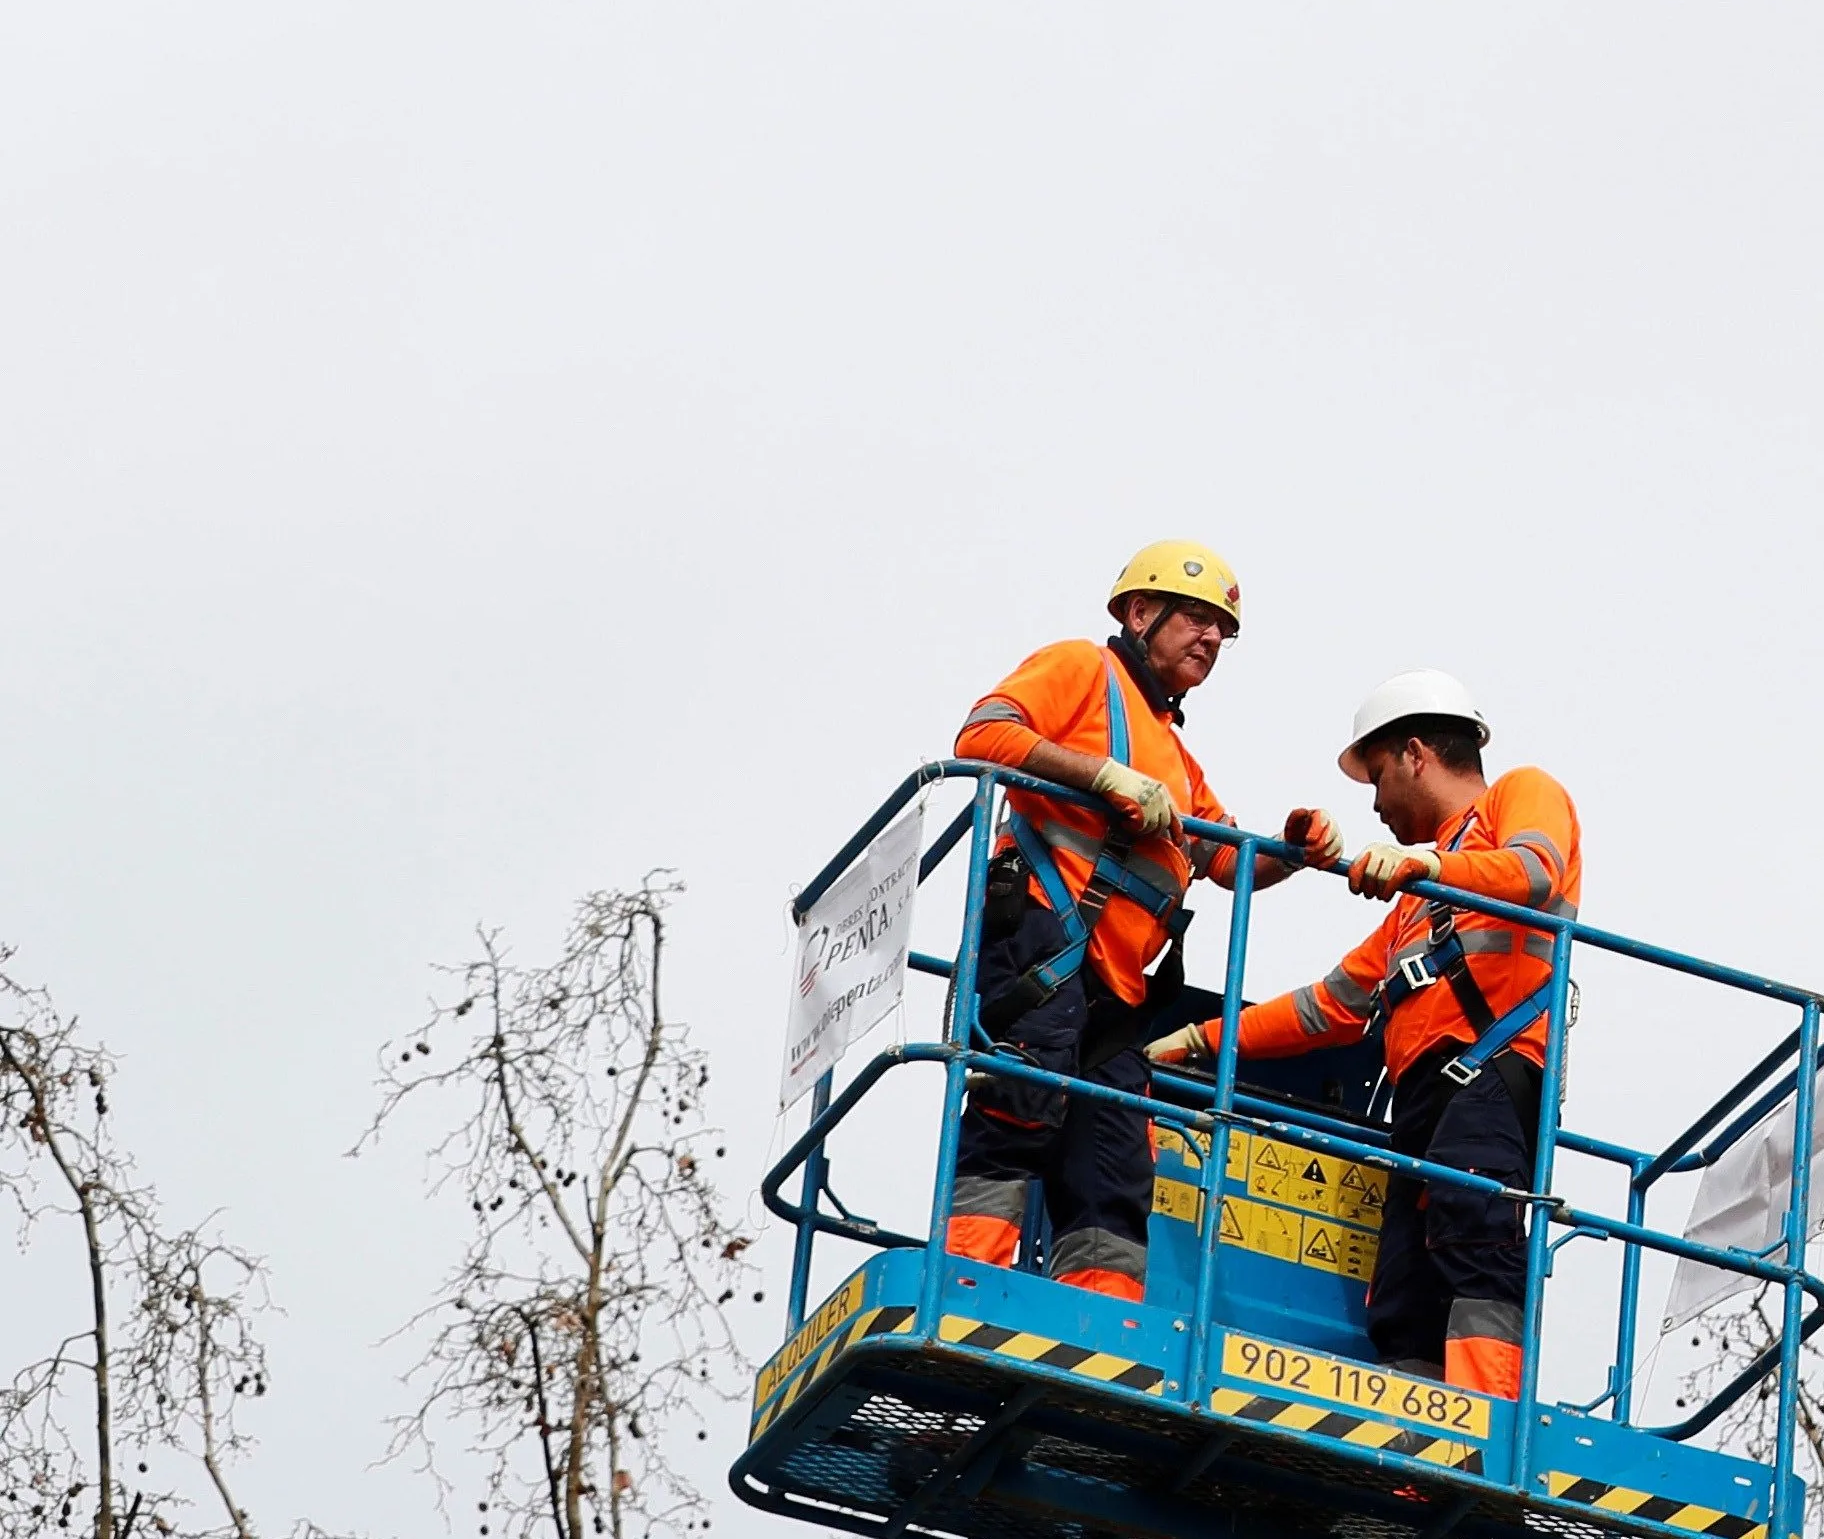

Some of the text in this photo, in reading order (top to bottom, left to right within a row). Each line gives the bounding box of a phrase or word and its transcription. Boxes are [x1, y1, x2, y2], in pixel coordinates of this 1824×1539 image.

[768, 1287, 849, 1393] ALQUILER
[1241, 1343, 1472, 1430] 902 119 682
